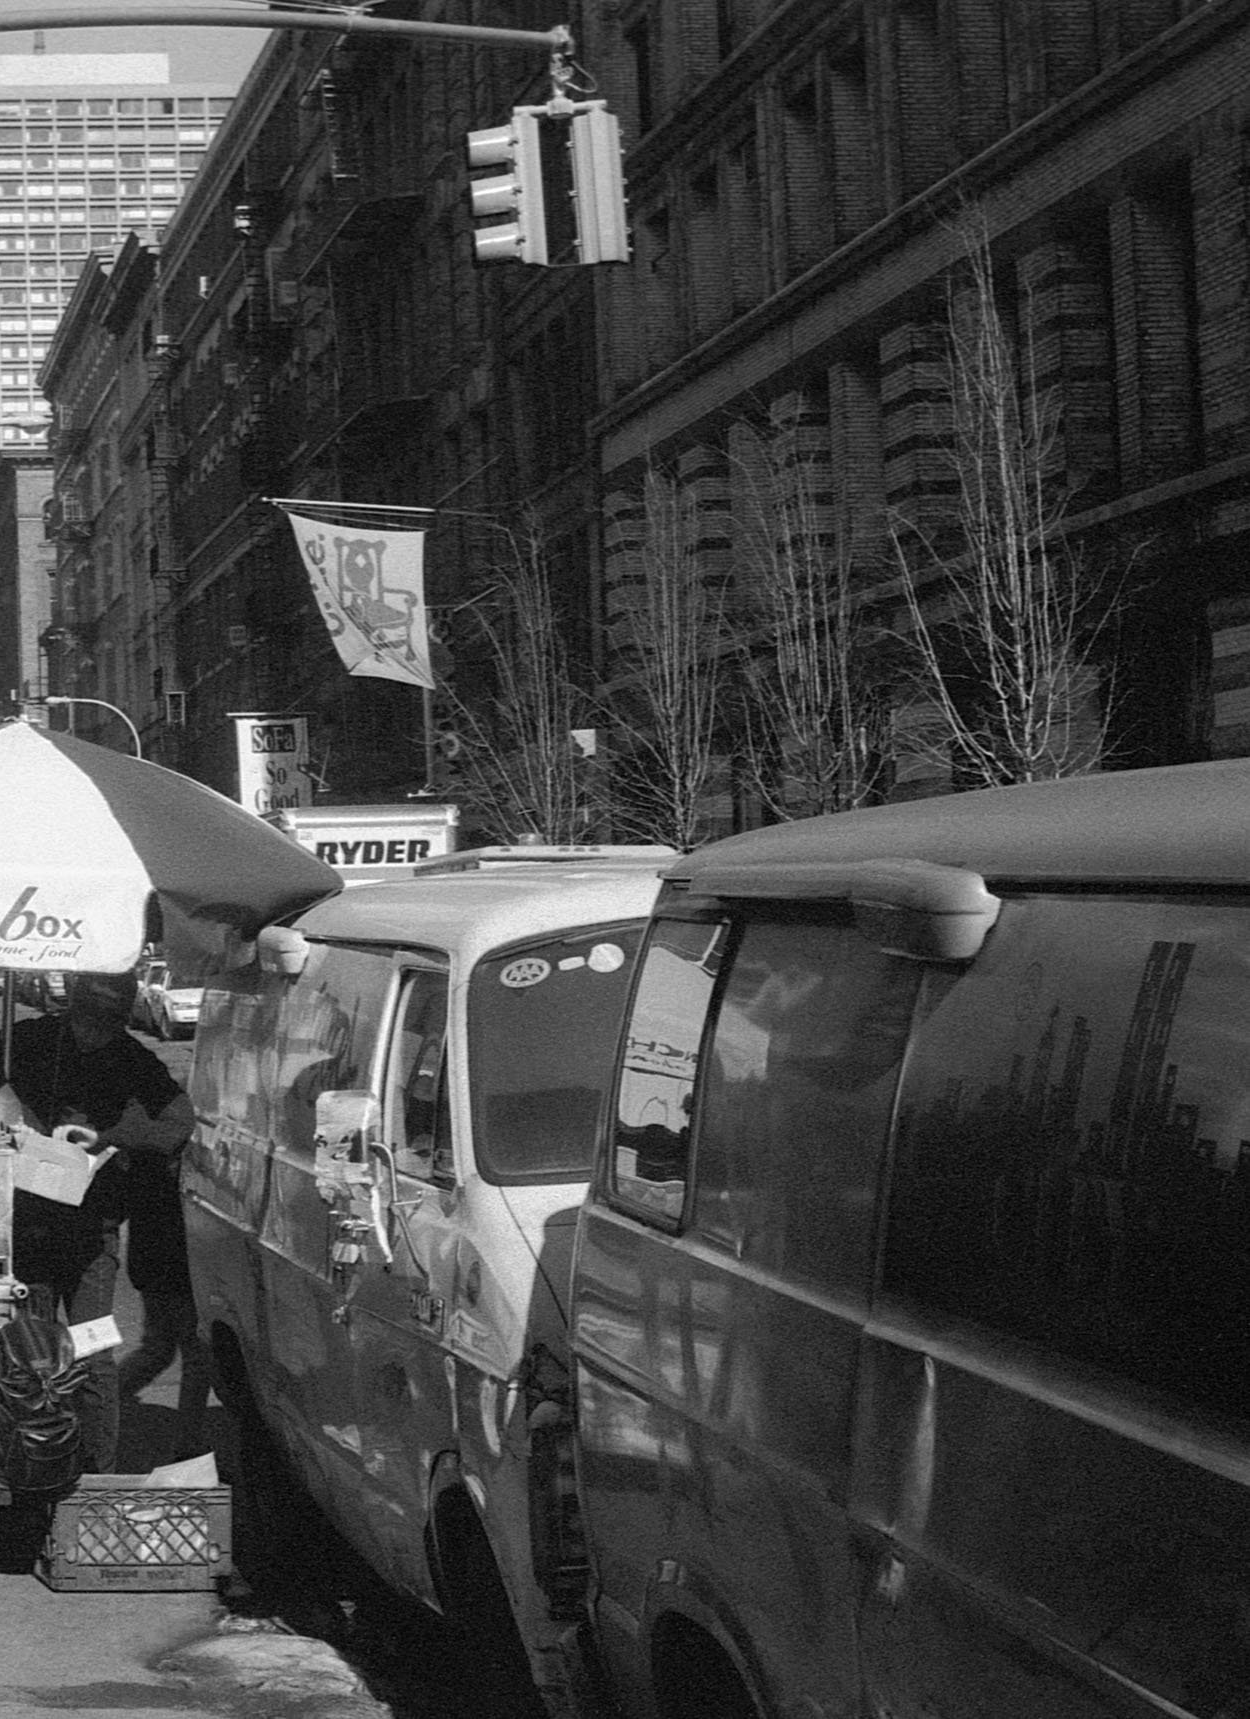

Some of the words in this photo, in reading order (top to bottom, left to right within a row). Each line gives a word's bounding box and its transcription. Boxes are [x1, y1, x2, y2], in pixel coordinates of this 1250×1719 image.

[266, 760, 287, 786] So
[254, 787, 300, 813] Good
[316, 839, 431, 866] RYDER
[29, 944, 83, 963] food
[508, 963, 545, 982] AAA
